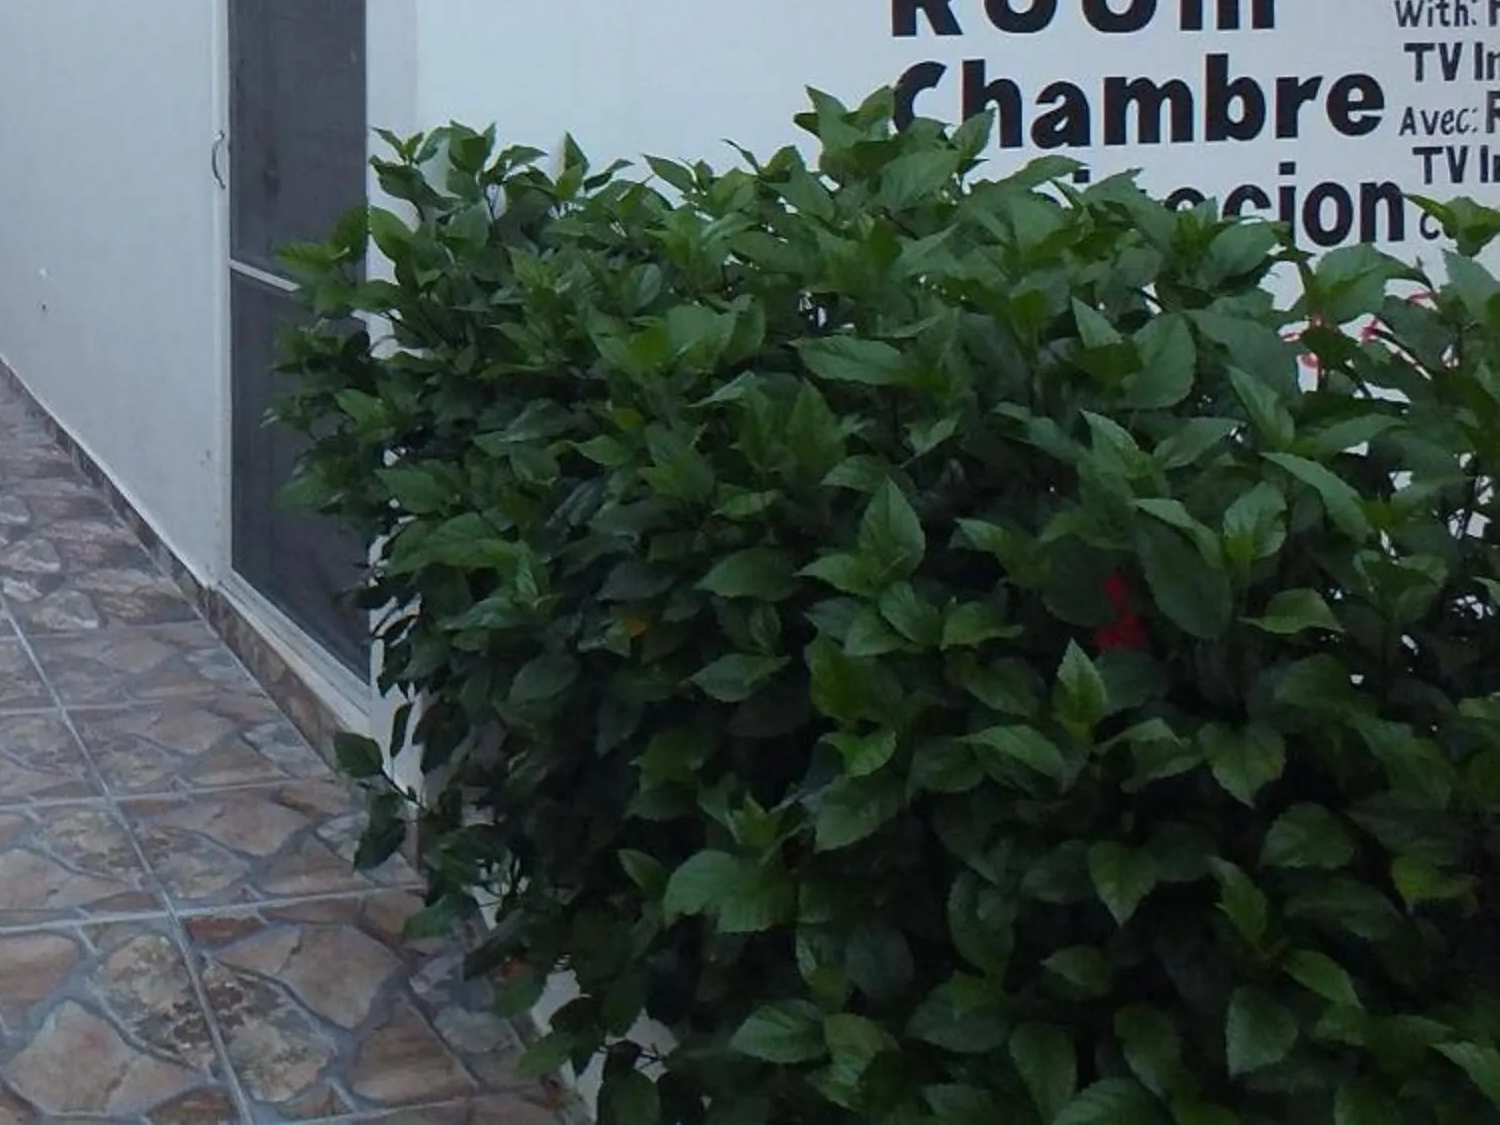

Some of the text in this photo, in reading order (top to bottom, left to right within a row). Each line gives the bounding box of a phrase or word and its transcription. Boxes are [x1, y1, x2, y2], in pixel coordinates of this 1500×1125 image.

[1404, 42, 1463, 82] TV
[894, 52, 1386, 149] Chambre
[1399, 106, 1478, 136] Avec:
[1412, 145, 1469, 185] TV
